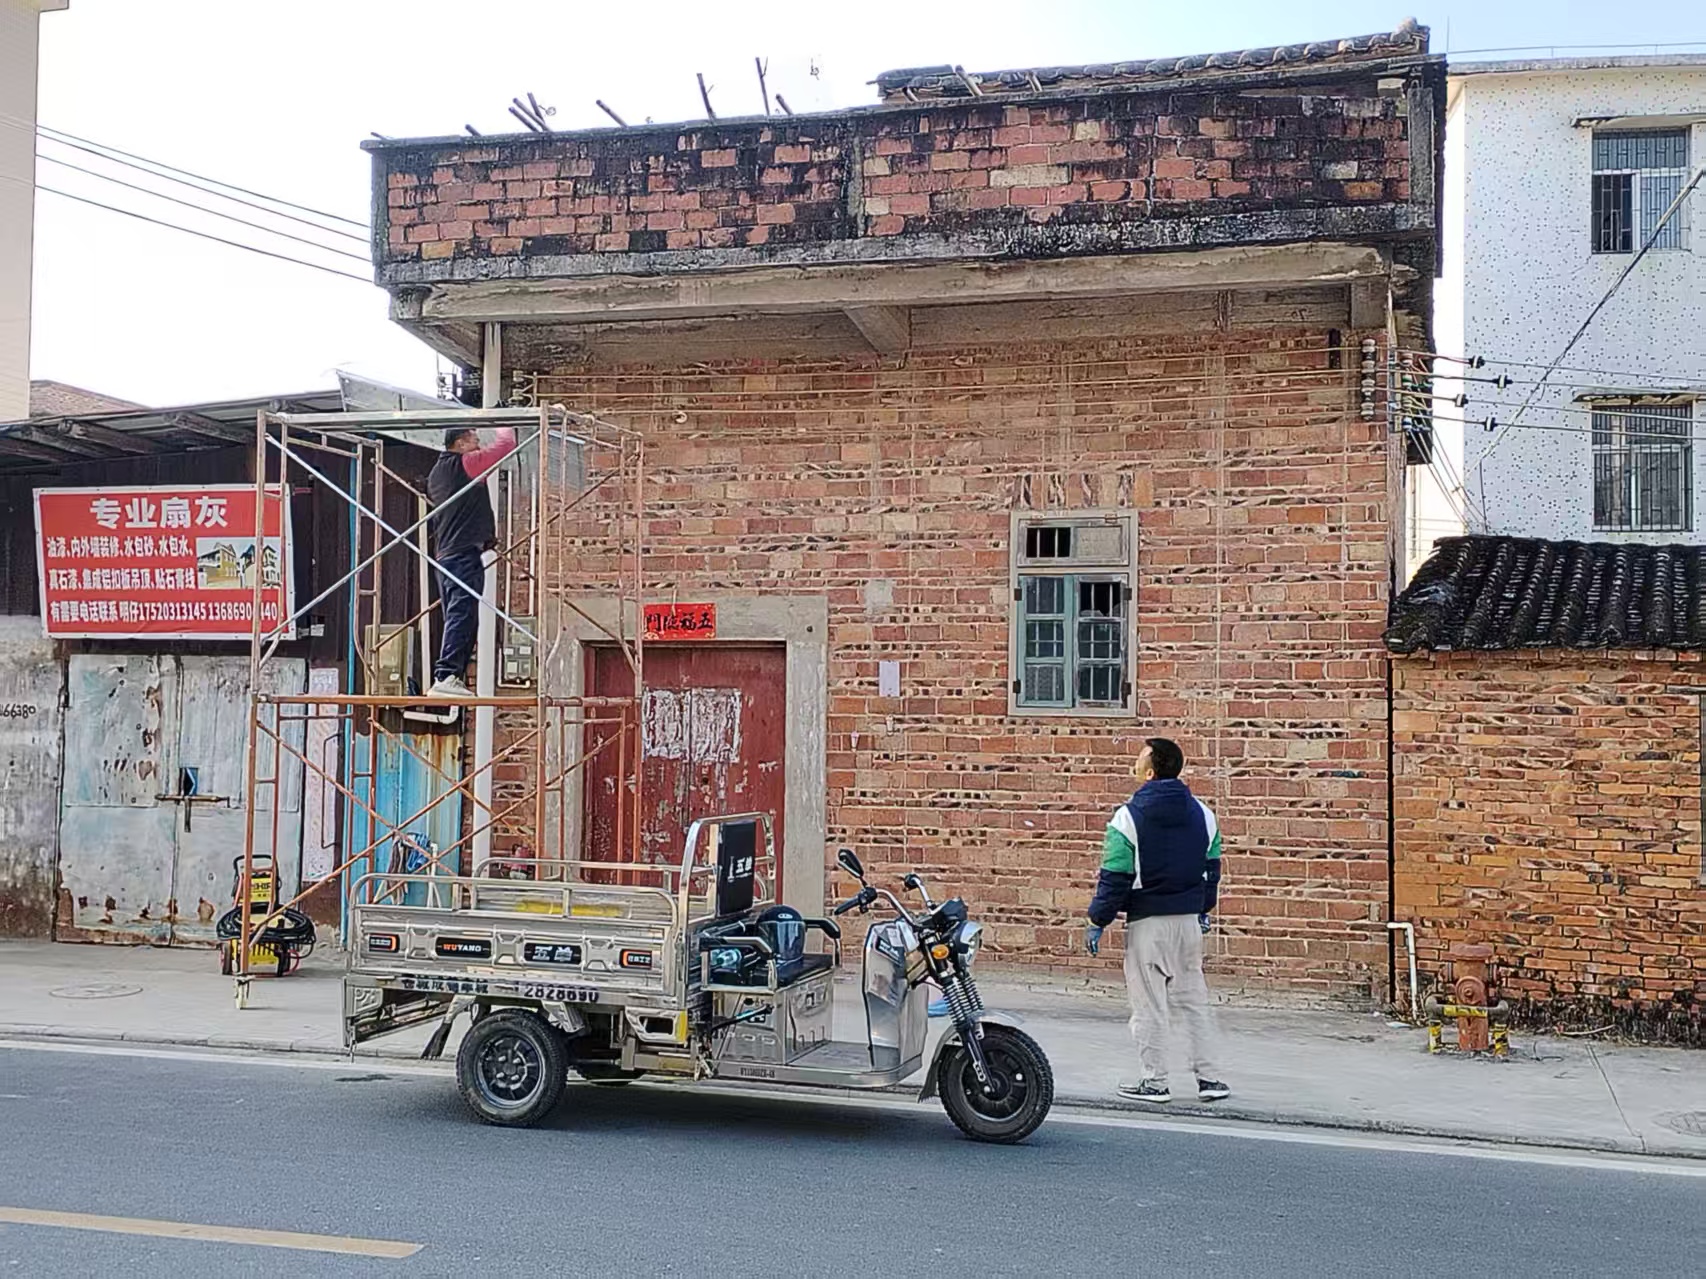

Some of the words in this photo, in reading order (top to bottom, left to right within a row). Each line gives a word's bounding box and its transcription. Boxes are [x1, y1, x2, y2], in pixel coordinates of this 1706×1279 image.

[89, 495, 229, 529] 专业扇灰
[50, 601, 118, 623] 有需要电话联系
[208, 601, 278, 622] 136869040
[443, 943, 482, 953] WUYANG
